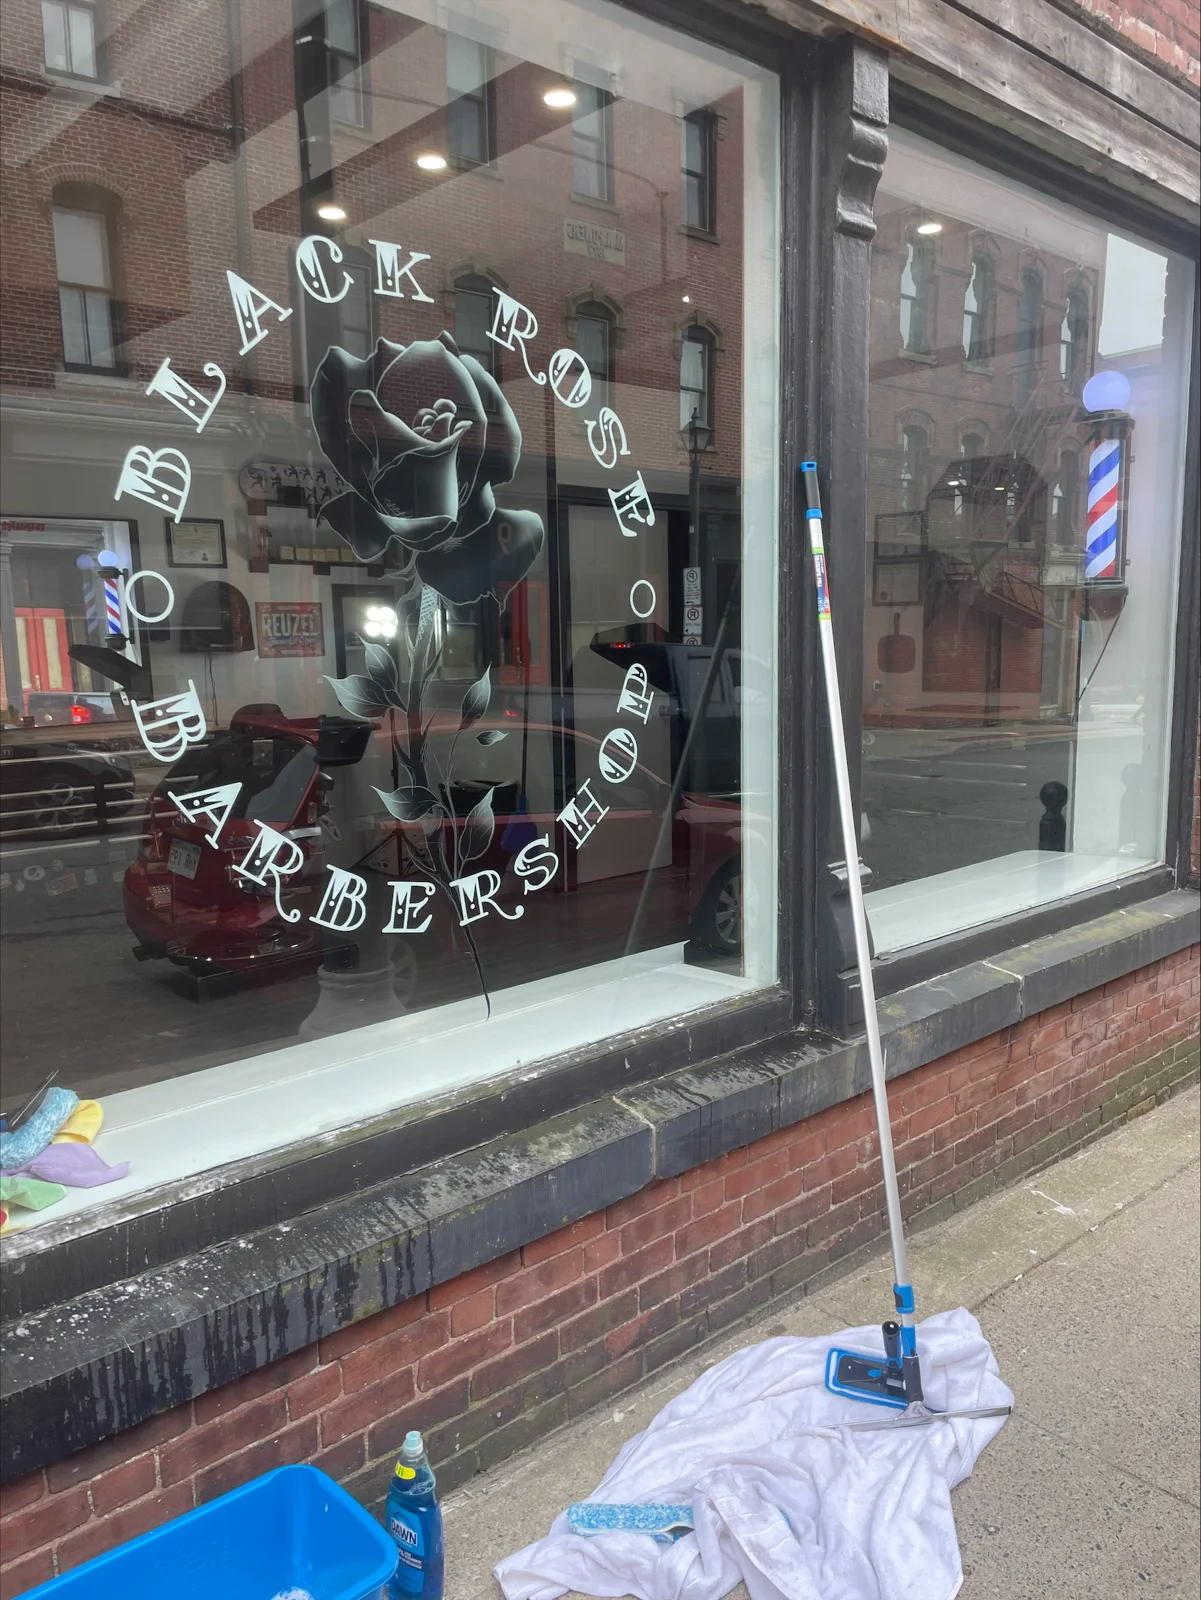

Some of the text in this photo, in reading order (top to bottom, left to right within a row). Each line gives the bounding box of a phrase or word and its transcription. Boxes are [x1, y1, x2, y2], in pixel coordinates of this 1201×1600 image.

[114, 235, 655, 537] BLACK ROSE
[261, 613, 318, 637] REUZEL
[130, 662, 655, 934] BARBERSHOP
[391, 1518, 417, 1546] DAWN
